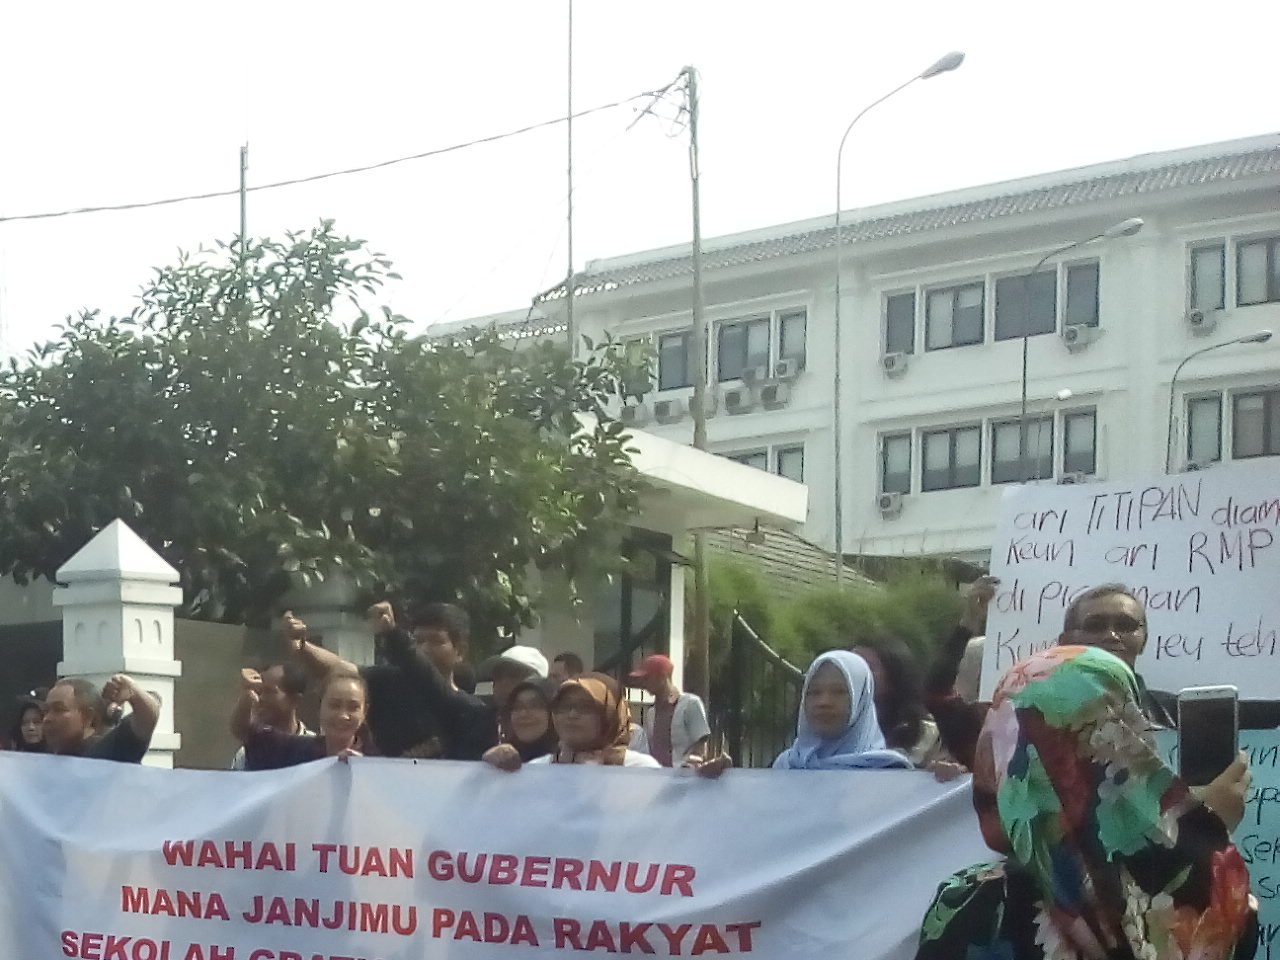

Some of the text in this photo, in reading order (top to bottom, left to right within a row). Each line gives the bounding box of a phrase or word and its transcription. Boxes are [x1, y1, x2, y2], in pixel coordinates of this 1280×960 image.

[1014, 508, 1068, 534] ari
[1086, 478, 1203, 535] TITIPAN
[1104, 542, 1158, 570] ari
[1188, 528, 1274, 575] RMP
[162, 839, 697, 897] WAHAI TUAN GUBERNUR
[121, 885, 762, 956] MANA JANJIMU PADA RAKYAT
